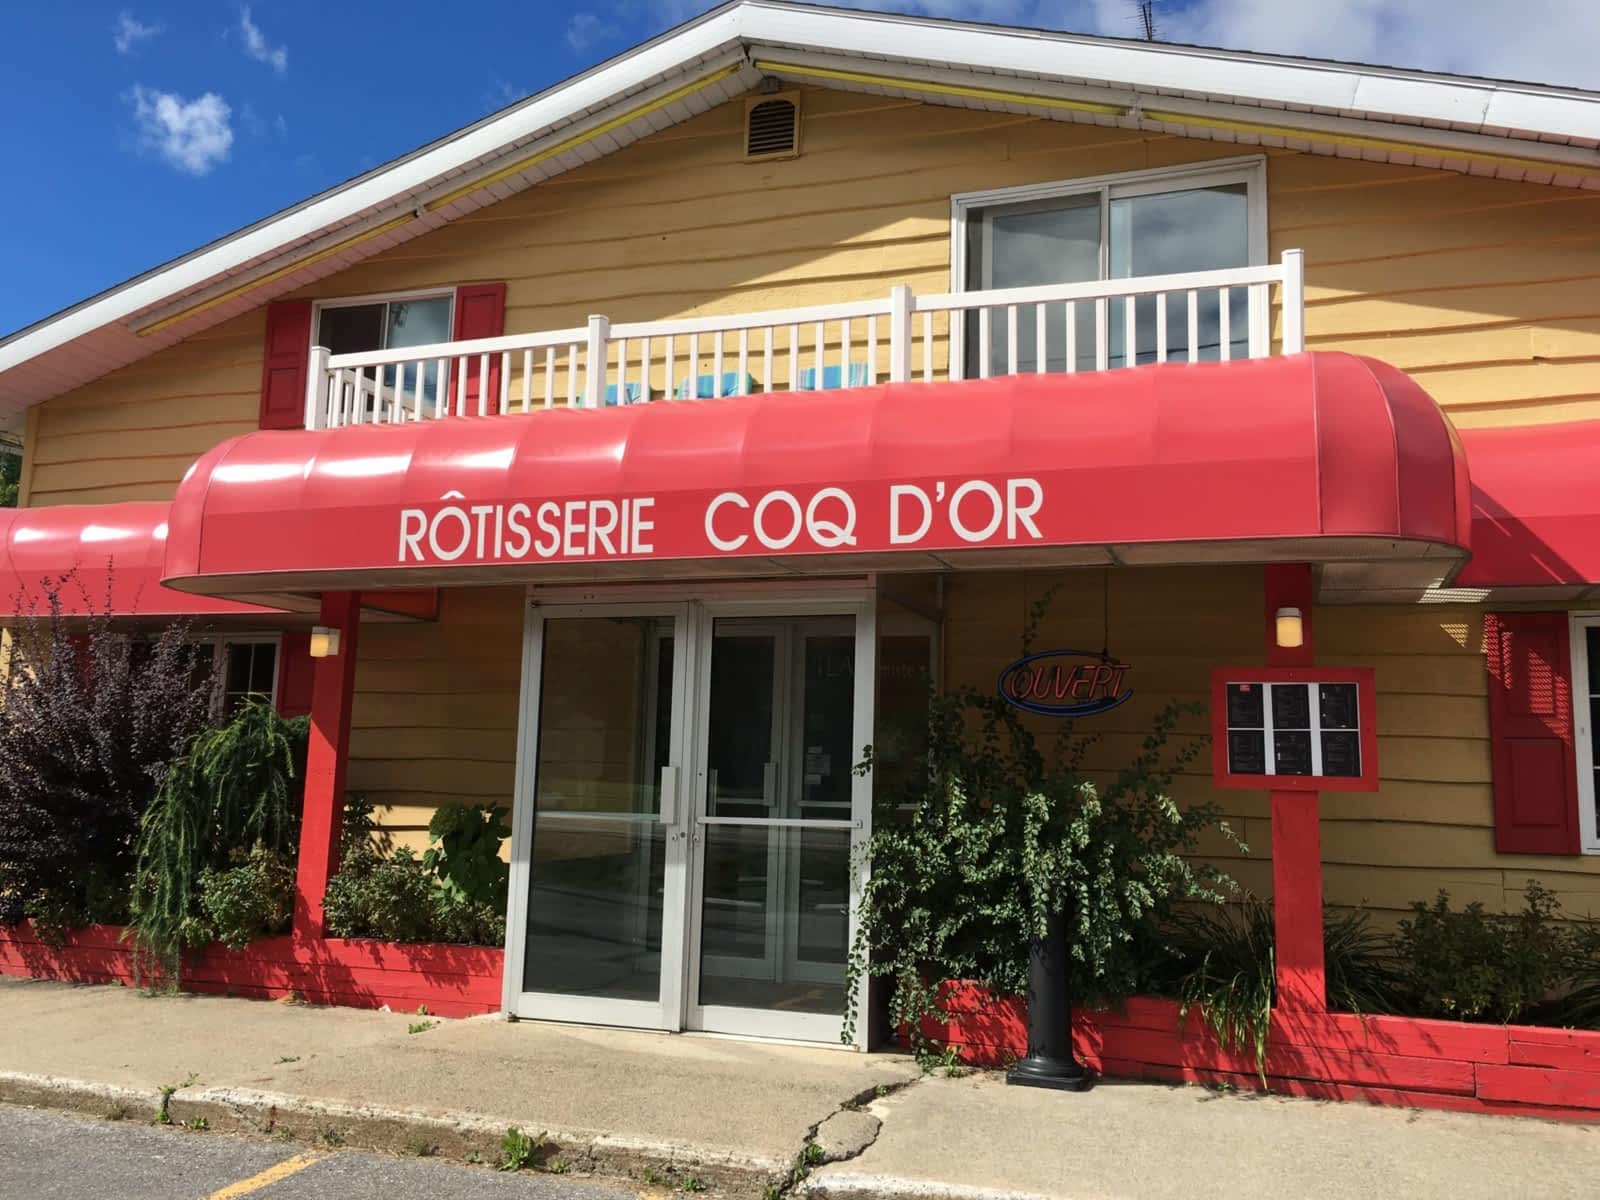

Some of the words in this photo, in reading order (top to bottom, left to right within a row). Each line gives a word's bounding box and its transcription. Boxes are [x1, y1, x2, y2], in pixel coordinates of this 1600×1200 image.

[398, 490, 655, 563] RÔTISSERIE
[704, 487, 858, 551] COQ
[889, 478, 1045, 546] D'OR
[1010, 664, 1132, 699] OUVERT
